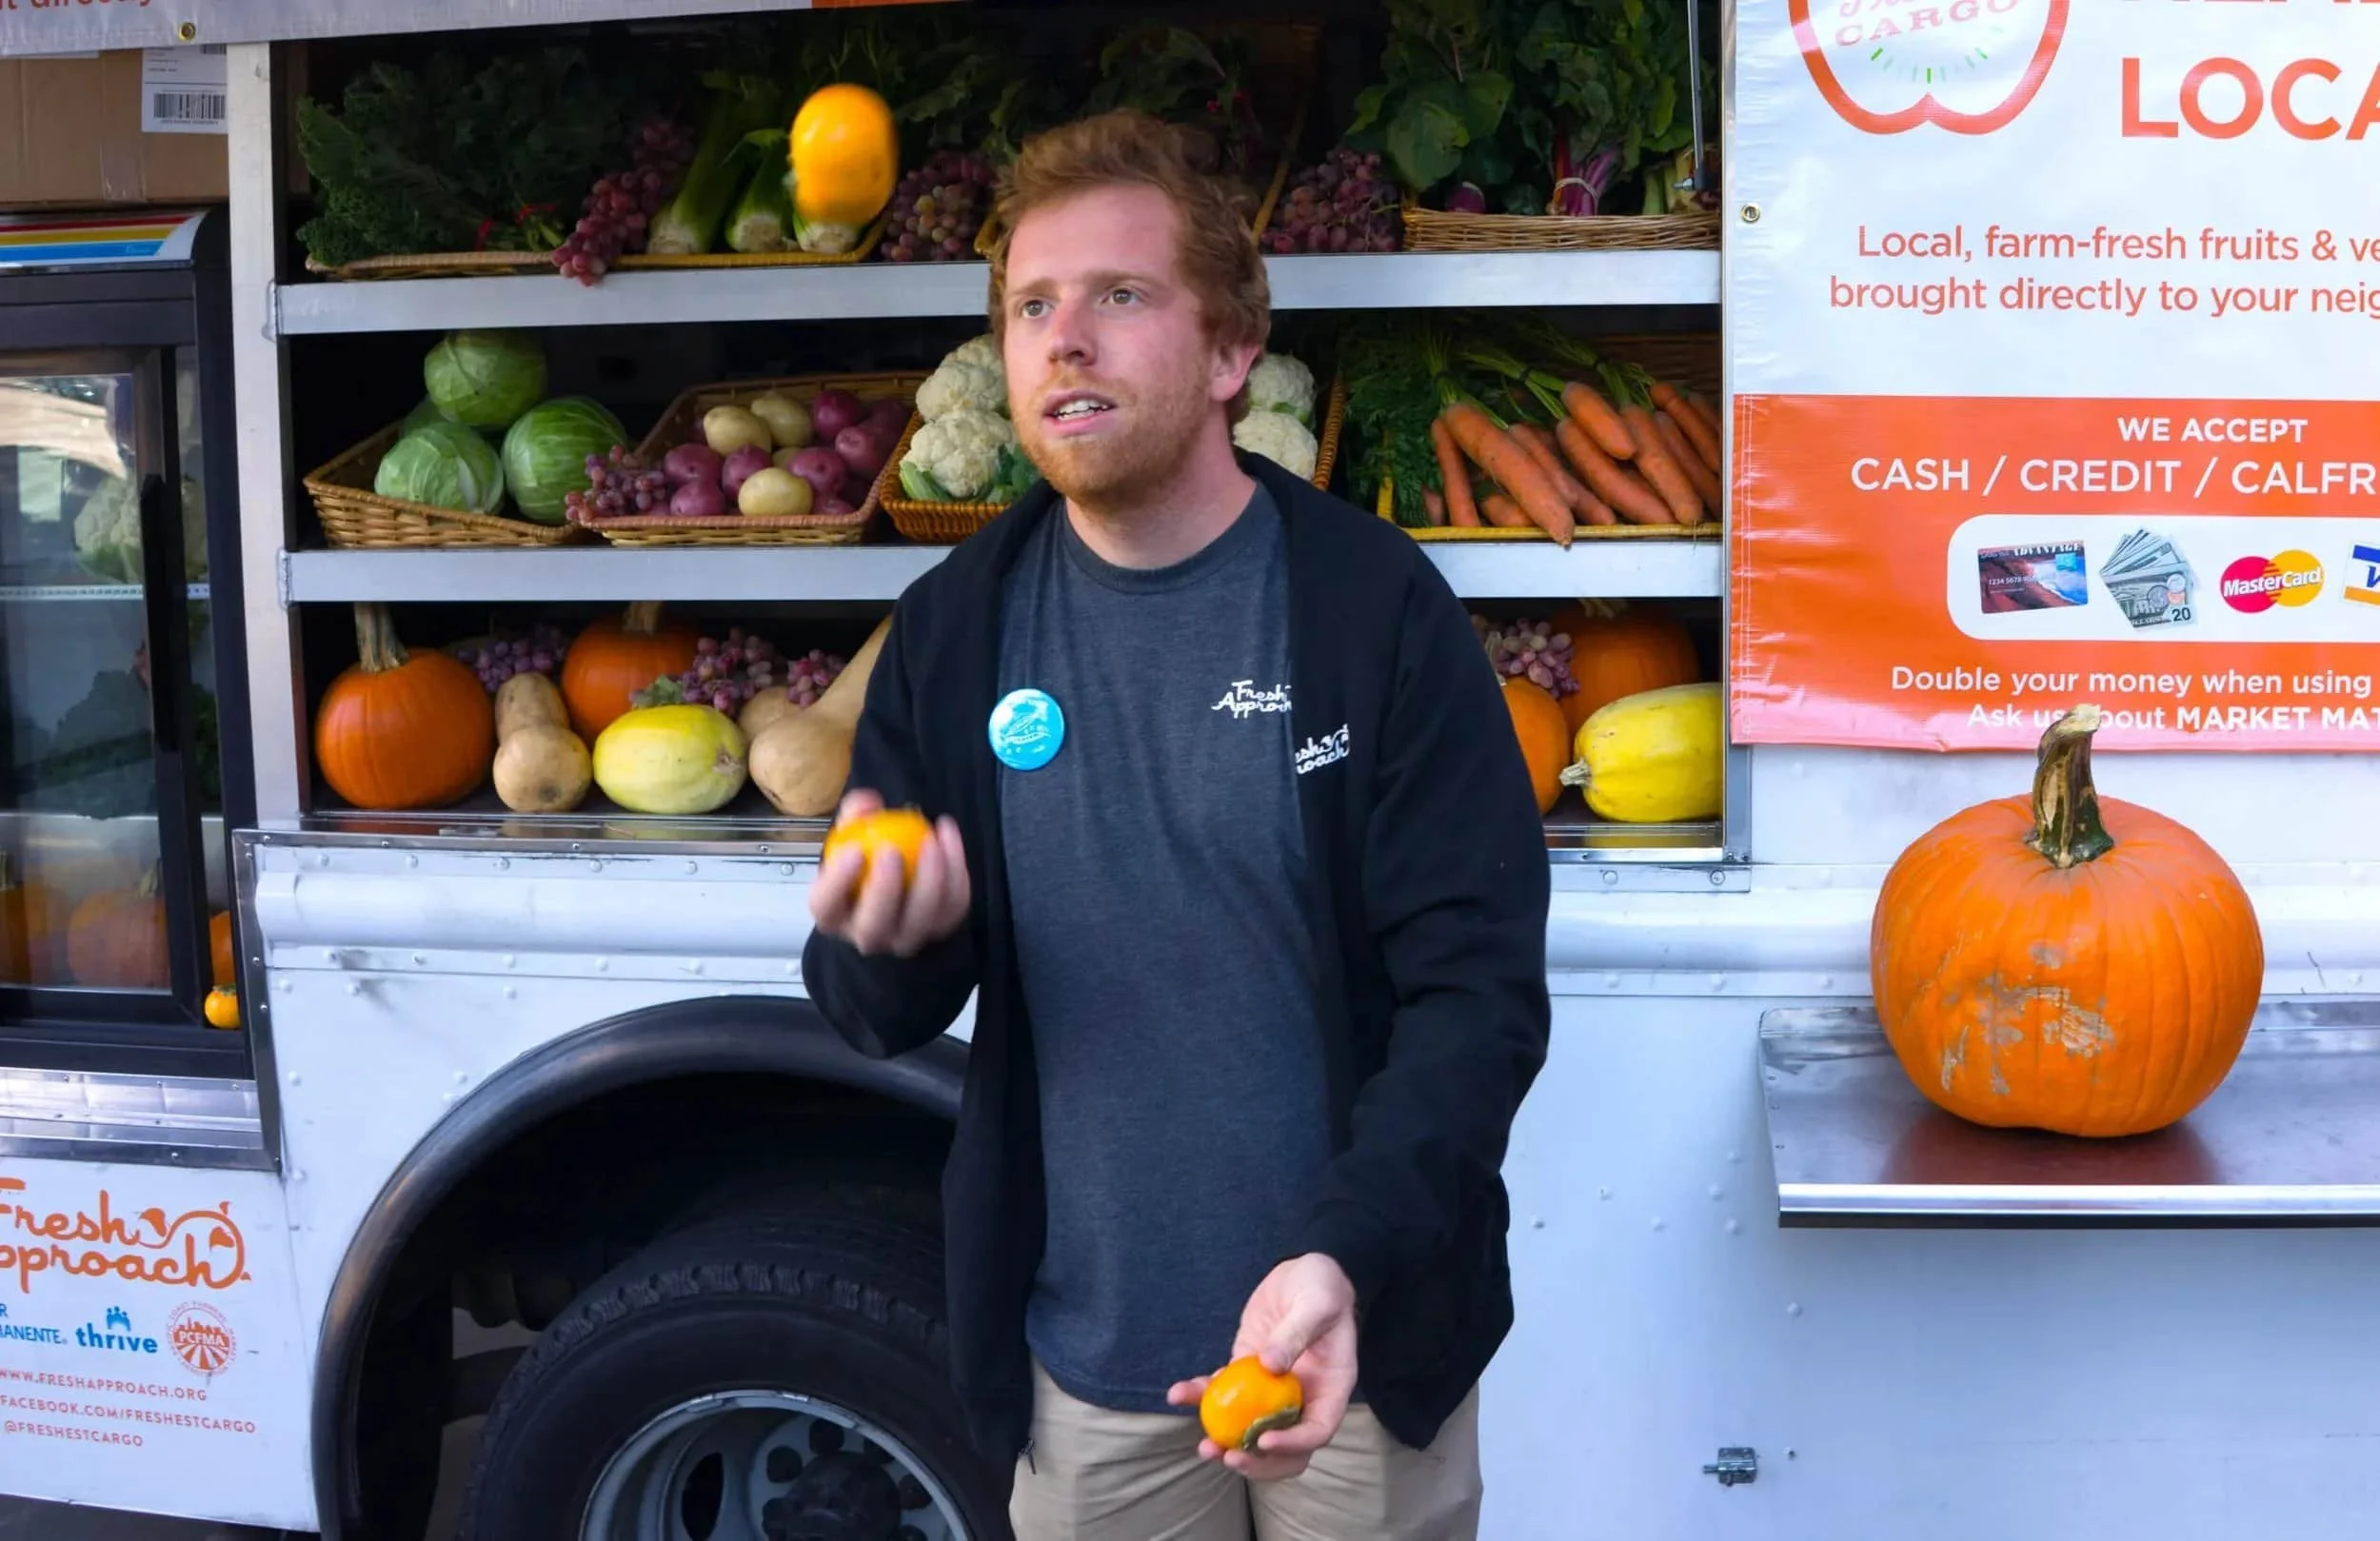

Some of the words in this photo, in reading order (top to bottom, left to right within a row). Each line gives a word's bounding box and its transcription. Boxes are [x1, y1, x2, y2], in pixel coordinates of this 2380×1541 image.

[1858, 225, 1973, 262] Local,
[1985, 225, 2188, 260] farm-fresh
[2199, 227, 2300, 262] fruits
[2311, 228, 2338, 262] &
[1830, 275, 1987, 315] brought
[1998, 277, 2148, 318] directly
[2158, 282, 2200, 312] to
[2211, 286, 2299, 319] your
[2117, 418, 2171, 442] WE
[2181, 418, 2309, 444] ACCEPT
[1851, 457, 1970, 492] CASH
[1982, 455, 2007, 496] /
[2020, 459, 2182, 493] CREDIT
[2193, 457, 2219, 498] /
[2231, 461, 2377, 495] CALFR
[2223, 567, 2321, 598] MasterCard
[2172, 606, 2192, 622] 20
[1892, 666, 2001, 691] Double
[2011, 673, 2080, 696] your
[2089, 673, 2192, 698] money
[2202, 668, 2282, 694] when
[2292, 669, 2371, 699] using
[1966, 703, 2023, 728] Ask
[2099, 707, 2166, 730] bout
[2175, 705, 2311, 731] MARKET
[75, 1323, 159, 1353] thrive
[5, 1420, 144, 1447] @FRESHESTCARGO
